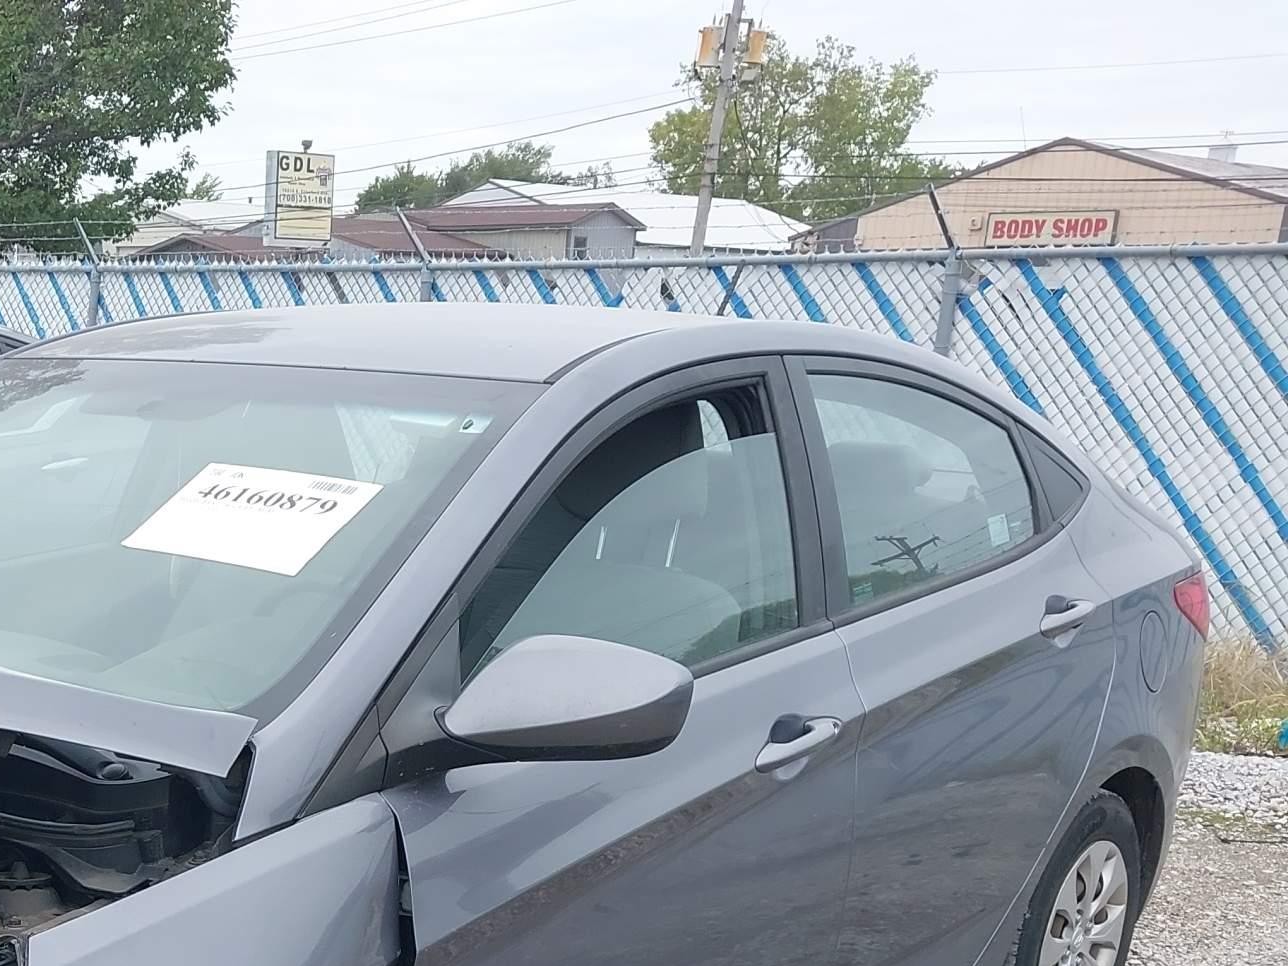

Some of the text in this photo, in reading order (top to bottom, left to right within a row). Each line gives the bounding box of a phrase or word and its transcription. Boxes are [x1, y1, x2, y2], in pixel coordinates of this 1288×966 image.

[280, 155, 314, 173] GDL
[992, 217, 1108, 239] BODY SHOP
[198, 484, 338, 515] 46160879
